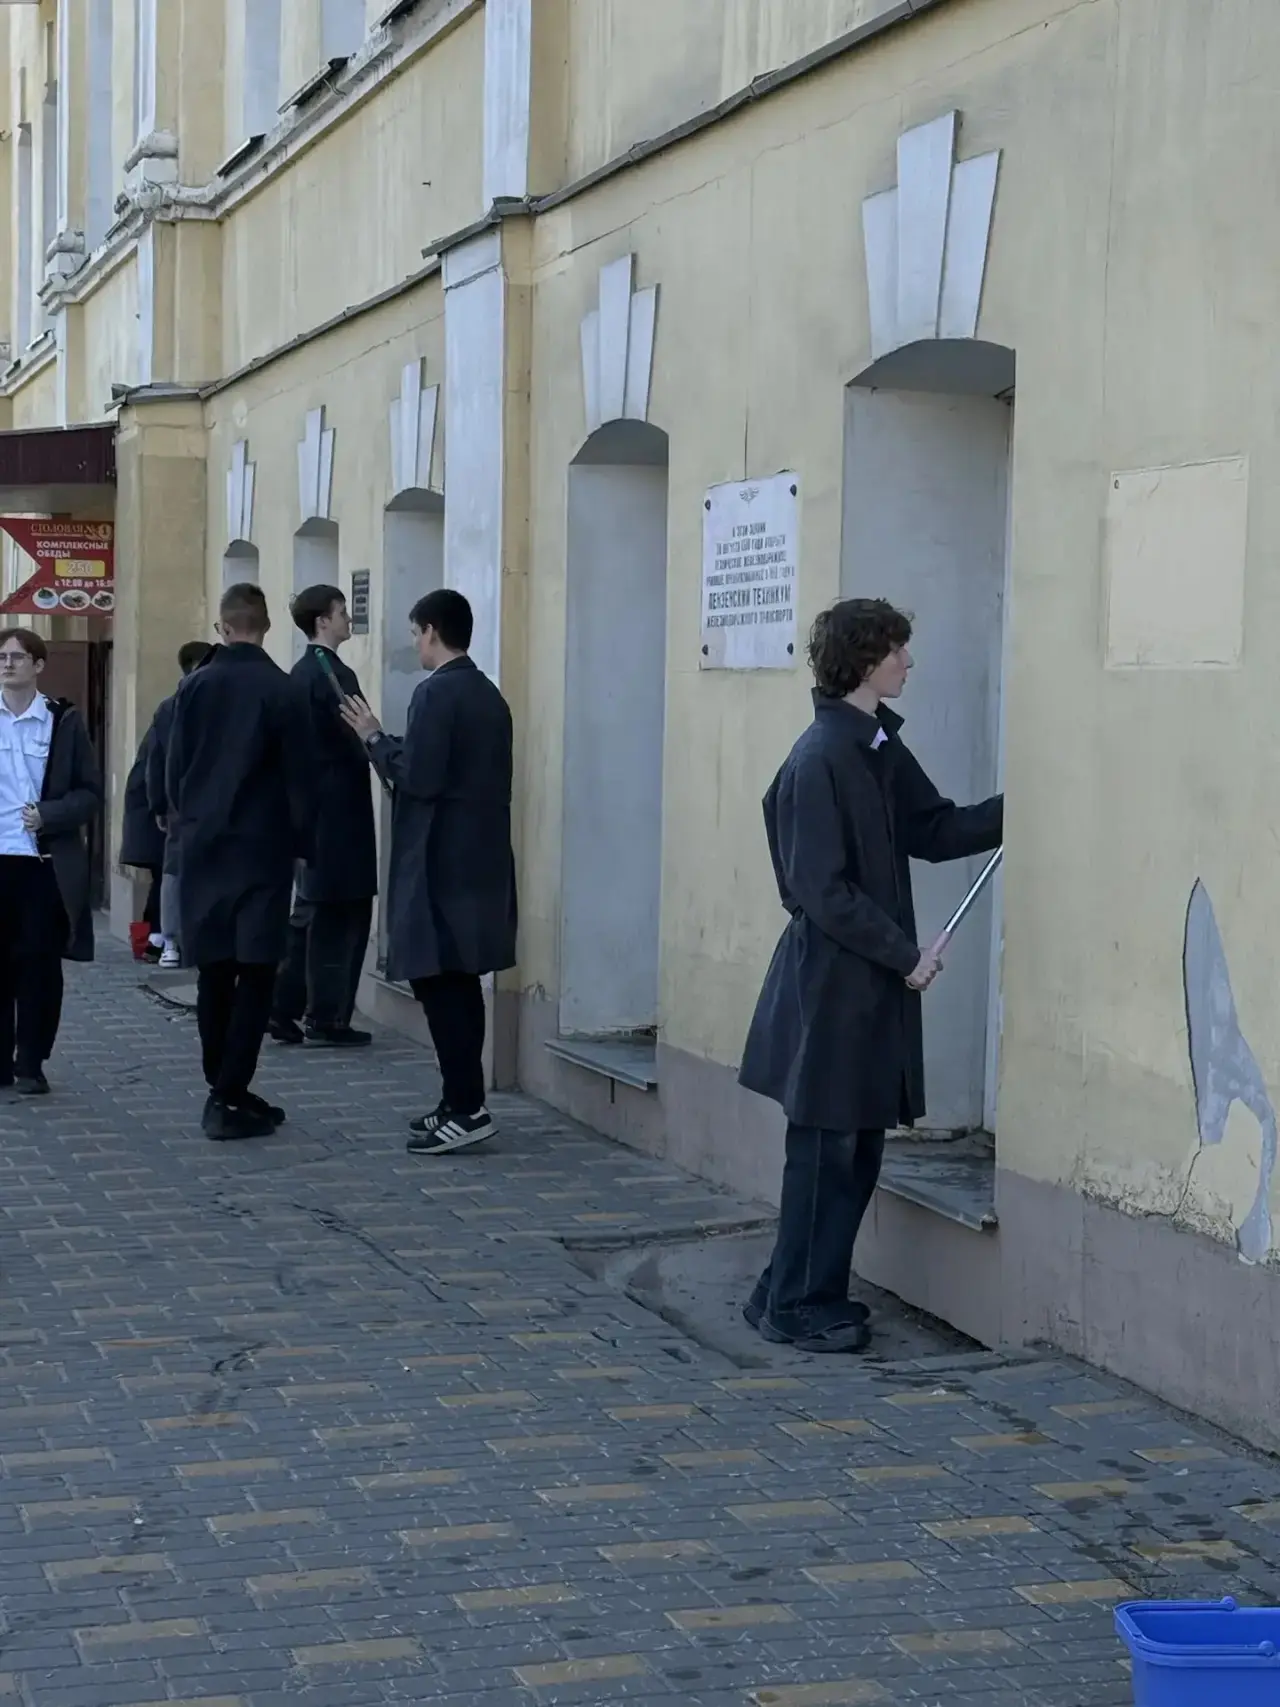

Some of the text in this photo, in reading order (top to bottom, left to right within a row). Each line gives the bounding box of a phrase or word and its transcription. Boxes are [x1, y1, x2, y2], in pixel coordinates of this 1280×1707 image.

[31, 523, 83, 533] СТОЛОВАЯ
[36, 540, 108, 550] КОМПЛЕКСНЫЕ
[36, 550, 71, 558] ОБЕДЫ
